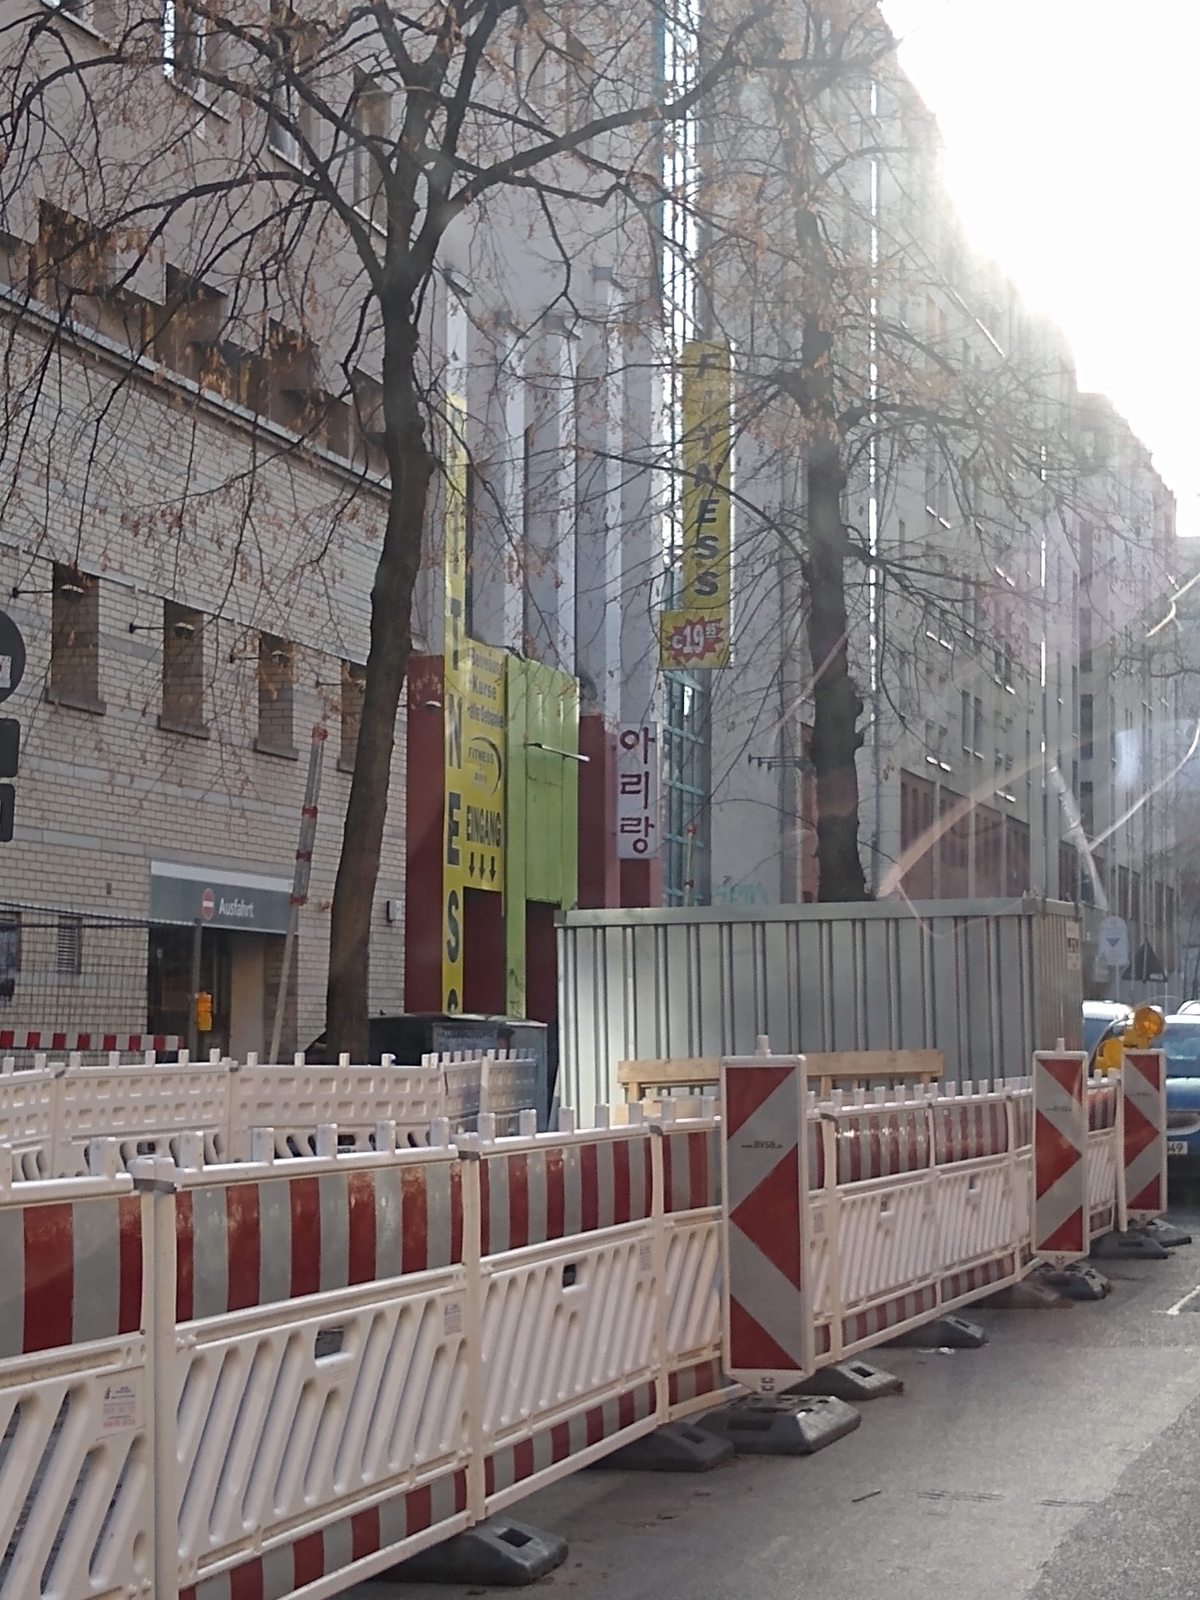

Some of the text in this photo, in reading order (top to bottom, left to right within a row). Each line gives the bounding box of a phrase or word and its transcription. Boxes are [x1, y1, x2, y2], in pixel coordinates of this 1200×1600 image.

[620, 727, 656, 853] 아리랑
[466, 805, 501, 848] EINGANG
[218, 897, 254, 918] Ausfahrt
